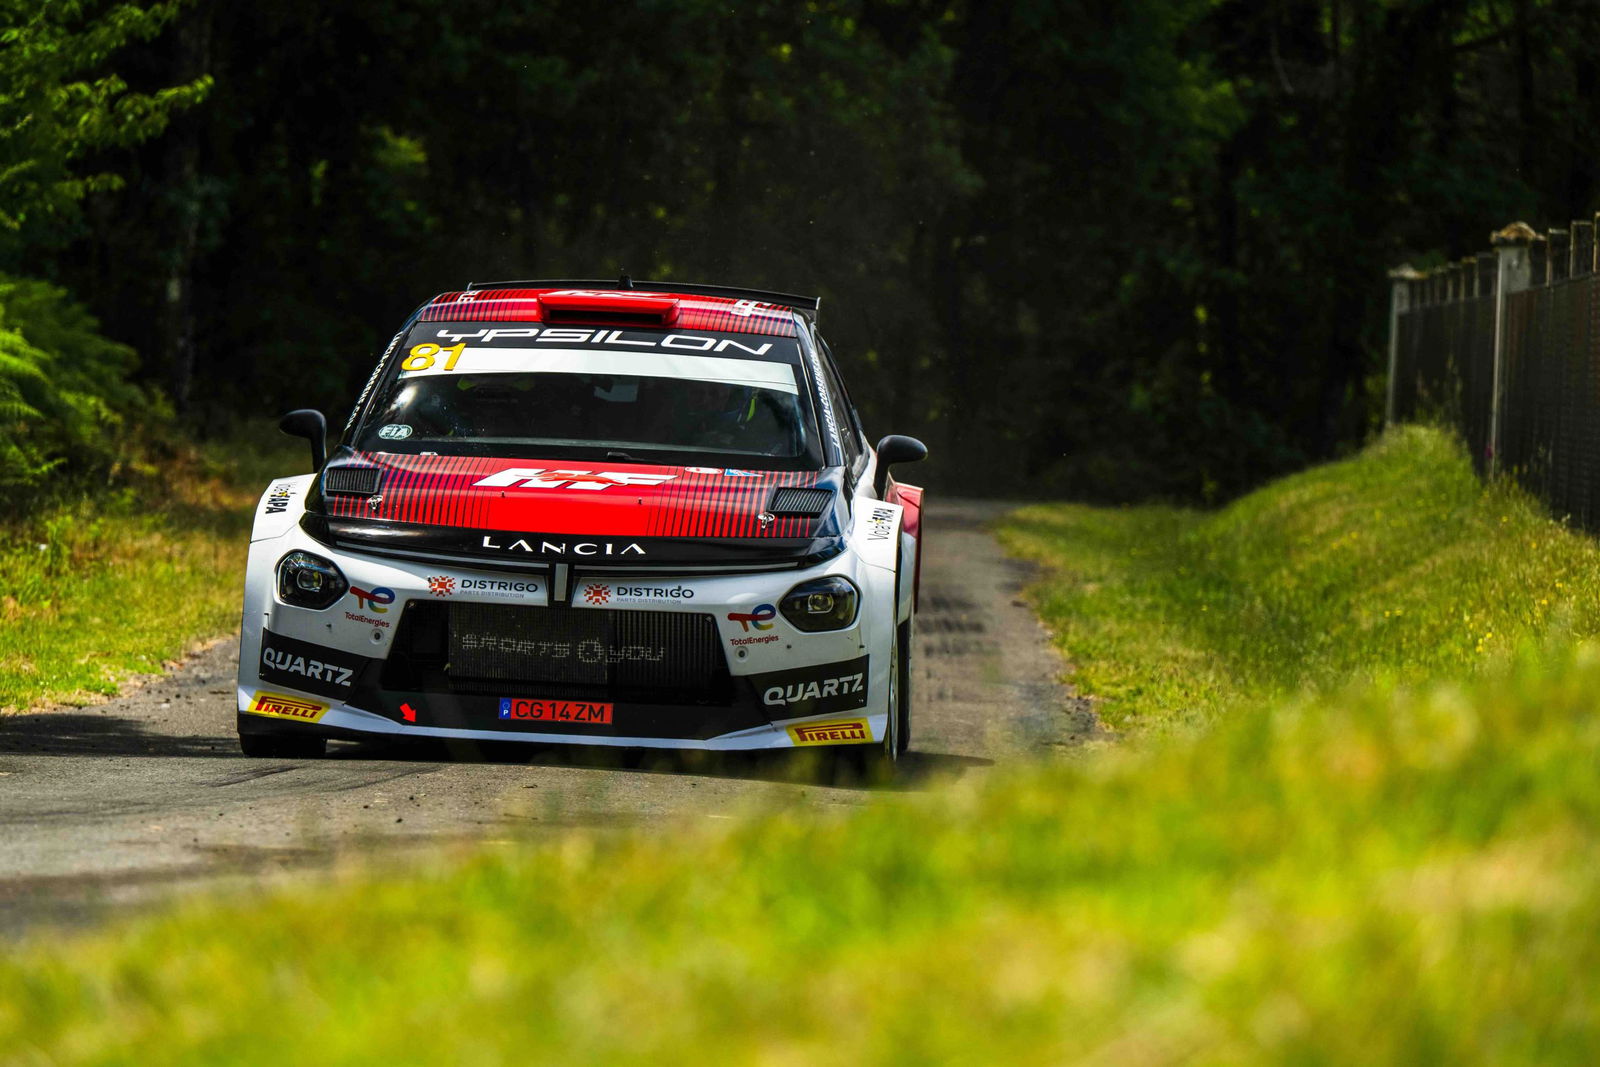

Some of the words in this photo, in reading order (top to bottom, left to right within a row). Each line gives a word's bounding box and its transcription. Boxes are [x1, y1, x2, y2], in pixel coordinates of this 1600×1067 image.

[436, 328, 773, 356] YPSILON
[401, 342, 467, 371] 81
[380, 425, 410, 439] FIA
[472, 467, 679, 491] HF
[482, 535, 647, 555] LANCIA
[461, 579, 539, 593] DISTRIGO
[481, 591, 525, 599] DISTRIBUTION
[616, 586, 695, 599] DISTRIGO
[345, 611, 390, 628] TotalEnergies
[730, 634, 780, 647] TotalEnergies
[263, 647, 354, 687] QUARTZ
[763, 672, 864, 706] QUARTZ
[255, 695, 323, 719] PIRELLI
[794, 722, 866, 742] PIRELLI
